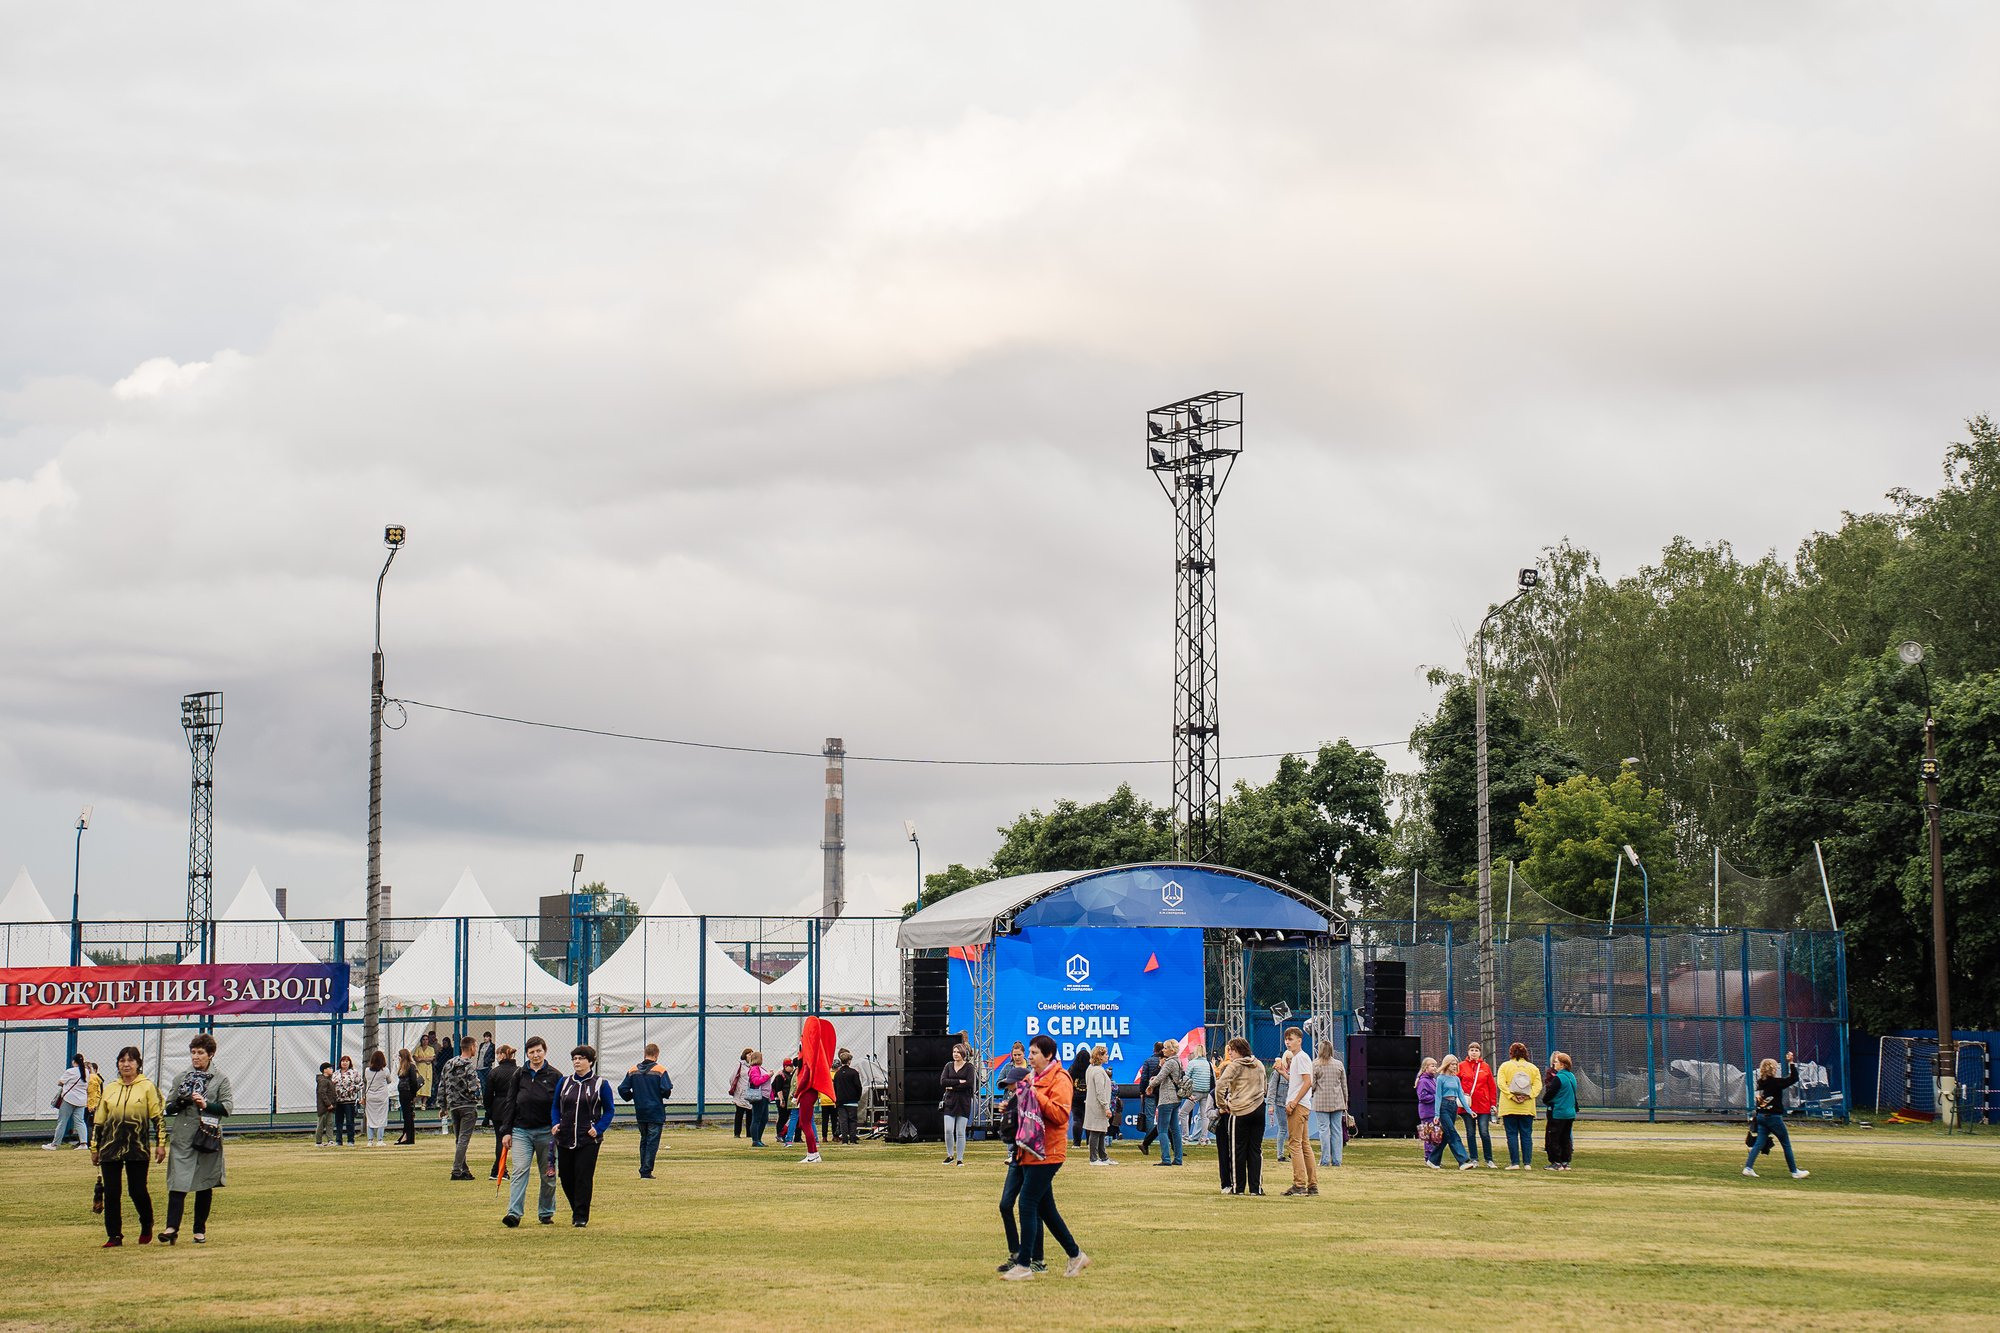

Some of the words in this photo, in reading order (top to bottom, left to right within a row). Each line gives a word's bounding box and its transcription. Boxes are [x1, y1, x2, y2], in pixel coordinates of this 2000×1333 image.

[17, 979, 215, 1010] РОЖДЕНИЯ,
[222, 977, 332, 1005] ЗАВОД!
[1037, 1001, 1077, 1011] Семейный
[1078, 1001, 1120, 1012] фестиваль
[1026, 1016, 1040, 1035] В
[1047, 1016, 1130, 1039] СЕРДЦЕ
